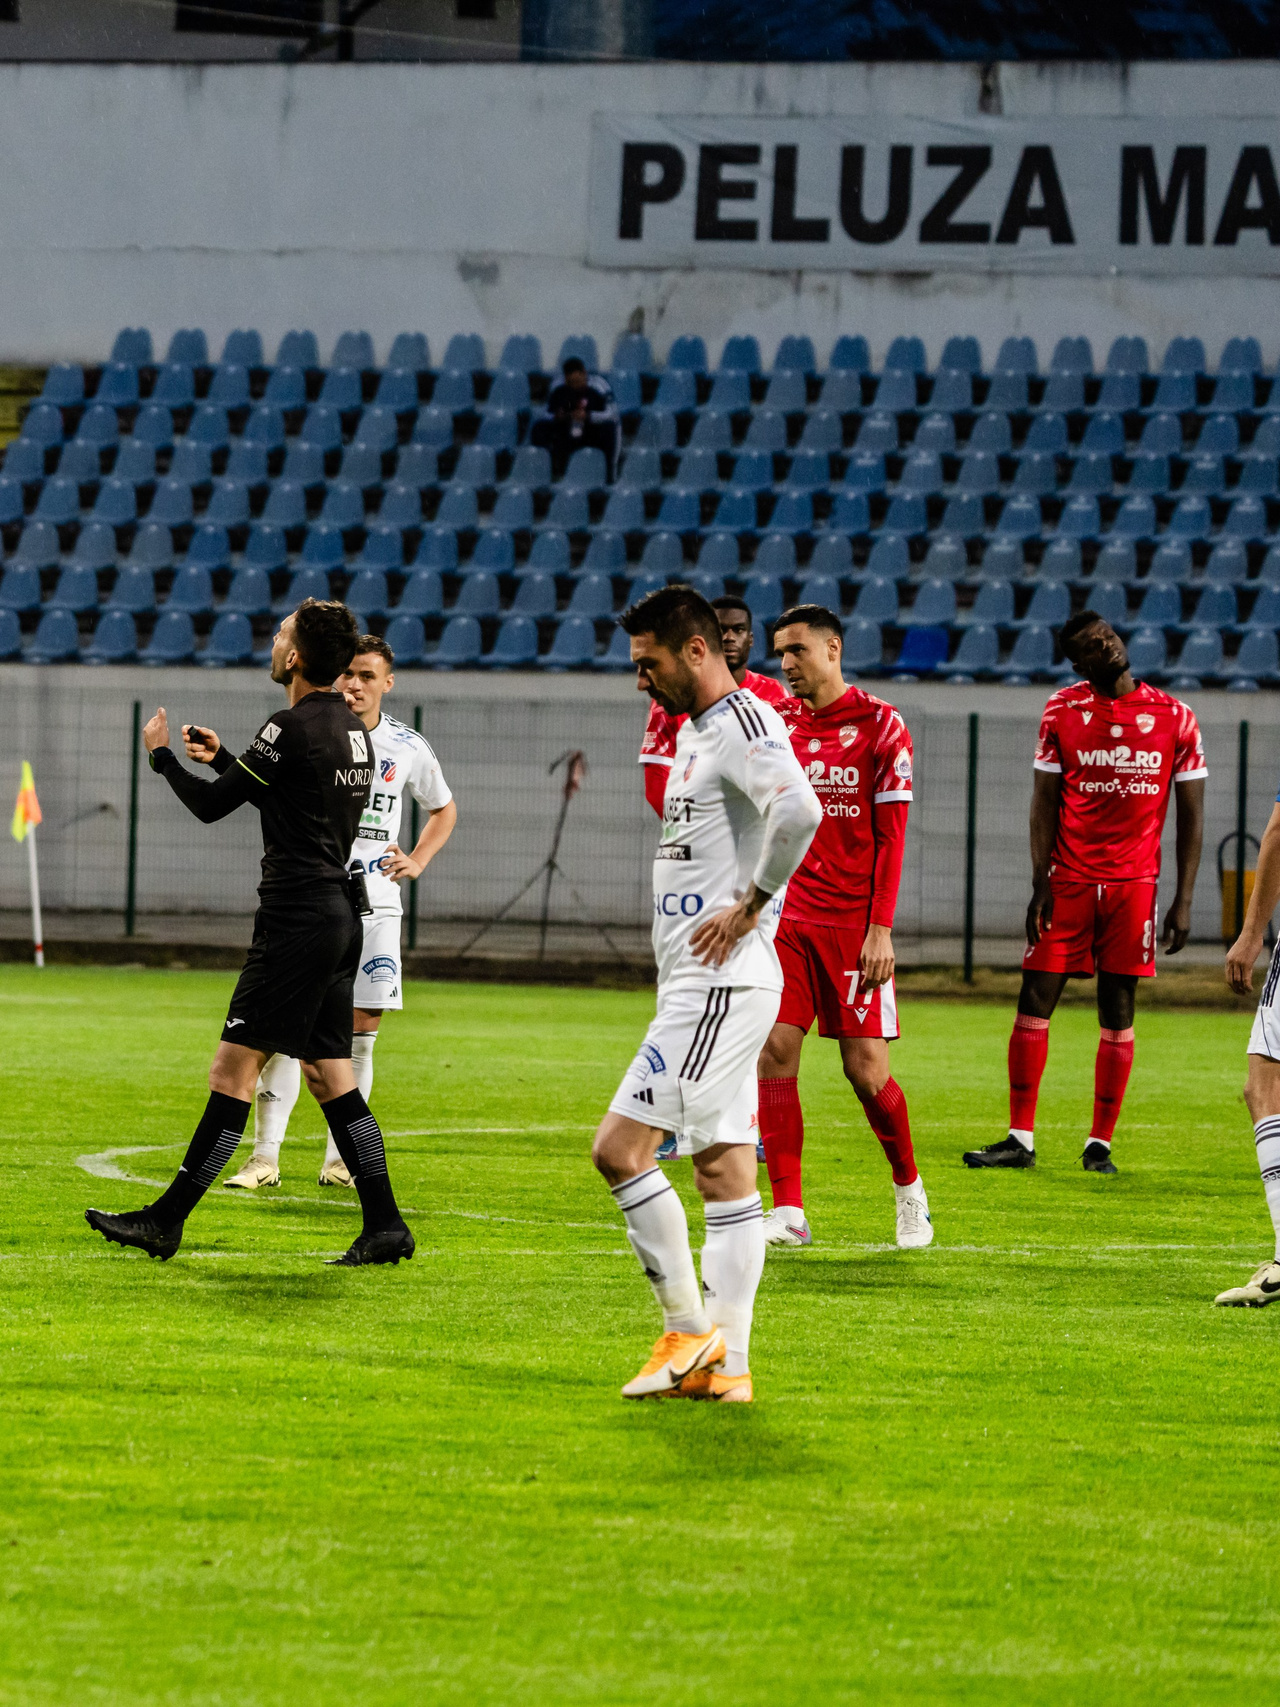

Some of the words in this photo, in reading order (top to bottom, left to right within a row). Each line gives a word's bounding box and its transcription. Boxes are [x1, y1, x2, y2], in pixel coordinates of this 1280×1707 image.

[618, 142, 1075, 245] PELUZA
[251, 738, 282, 762] ORDIS
[1076, 745, 1162, 769] WIN2.RO
[358, 829, 377, 839] SPRE
[1142, 919, 1153, 949] 8
